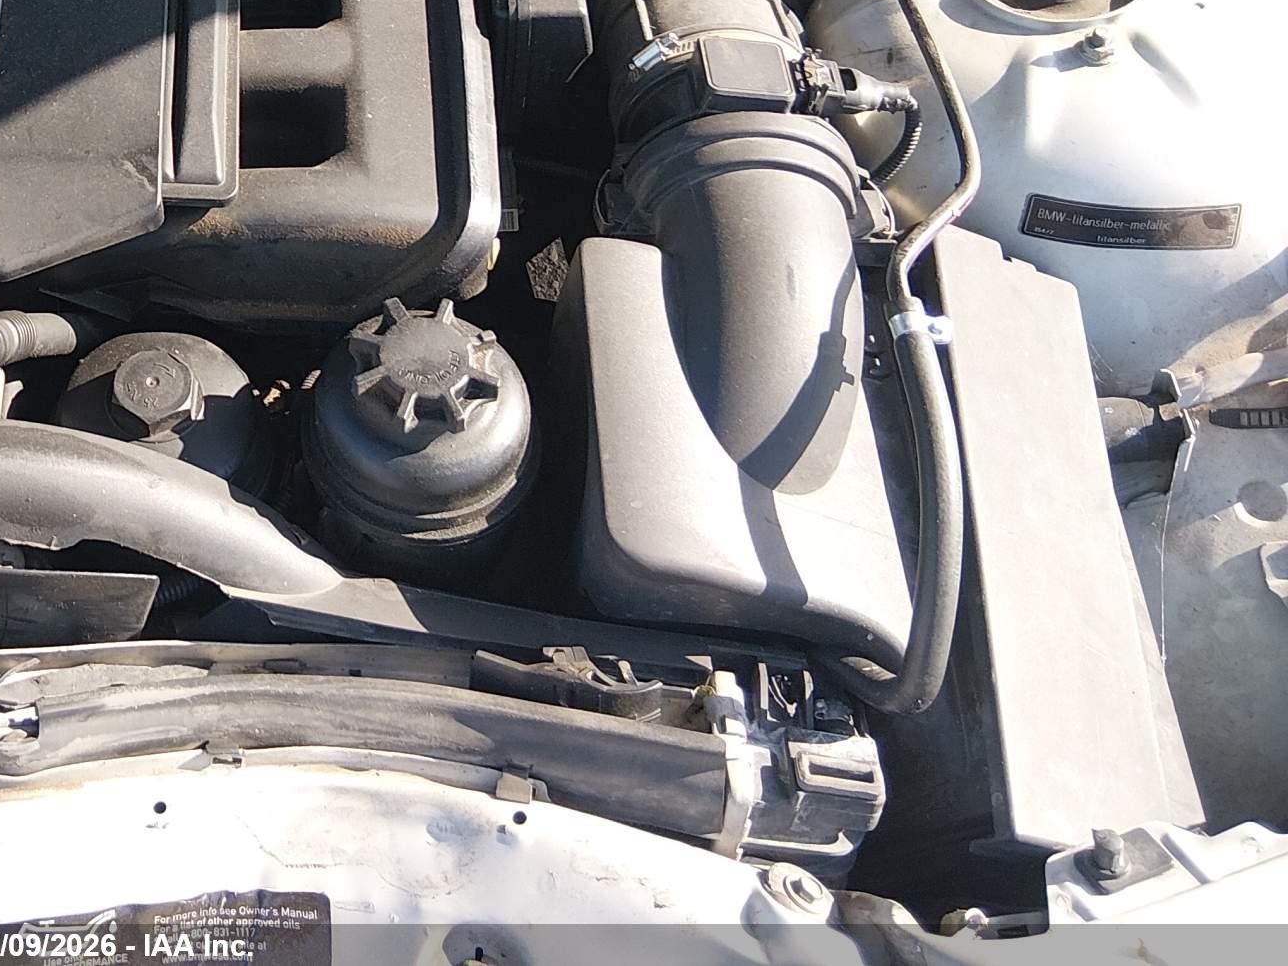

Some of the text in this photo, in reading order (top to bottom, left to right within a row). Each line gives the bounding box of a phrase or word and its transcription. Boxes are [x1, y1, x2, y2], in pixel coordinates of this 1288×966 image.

[1096, 235, 1146, 244] titansilber
[154, 915, 171, 925] For
[172, 910, 198, 923] more
[199, 906, 217, 917] info
[238, 905, 279, 917] Owner's
[281, 906, 318, 920] Manual
[207, 915, 234, 926] other
[235, 917, 281, 929] approved
